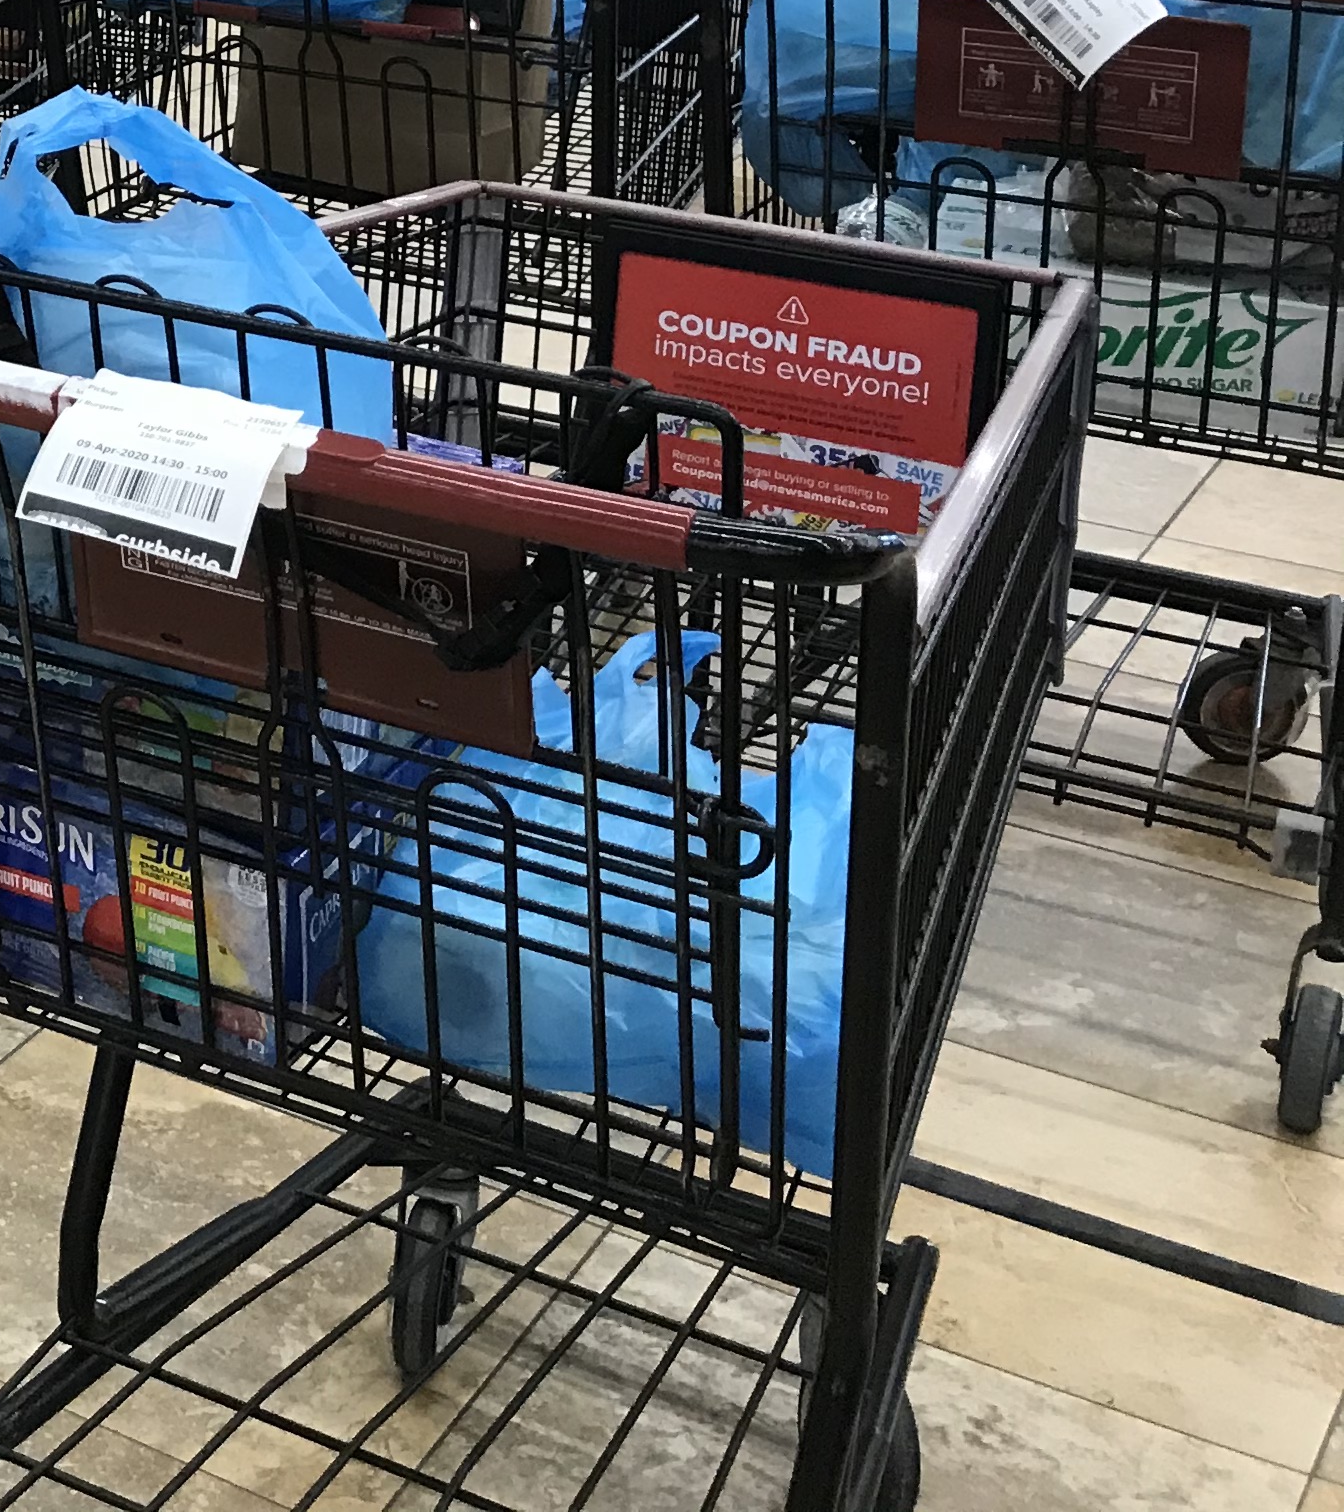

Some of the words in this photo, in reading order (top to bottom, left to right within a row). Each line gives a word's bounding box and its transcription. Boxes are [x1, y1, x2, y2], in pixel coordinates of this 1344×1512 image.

[658, 310, 798, 355] COUPON
[808, 336, 922, 376] FRAUD
[655, 334, 766, 375] impacts
[777, 360, 930, 405] everyone!
[176, 429, 208, 441] Gibbs
[658, 419, 685, 436] AVE
[76, 439, 149, 462] 09-Apr-2020
[150, 454, 184, 470] 14:30
[194, 465, 228, 479] 15:00
[672, 448, 711, 467] Report
[774, 468, 816, 488] buying
[818, 479, 831, 489] or
[833, 483, 875, 502] selling
[877, 491, 890, 502] to
[896, 461, 944, 486] SAVE
[672, 461, 890, 516] Couponud@newsamerica.com
[359, 536, 400, 552] serious
[402, 544, 431, 559] head
